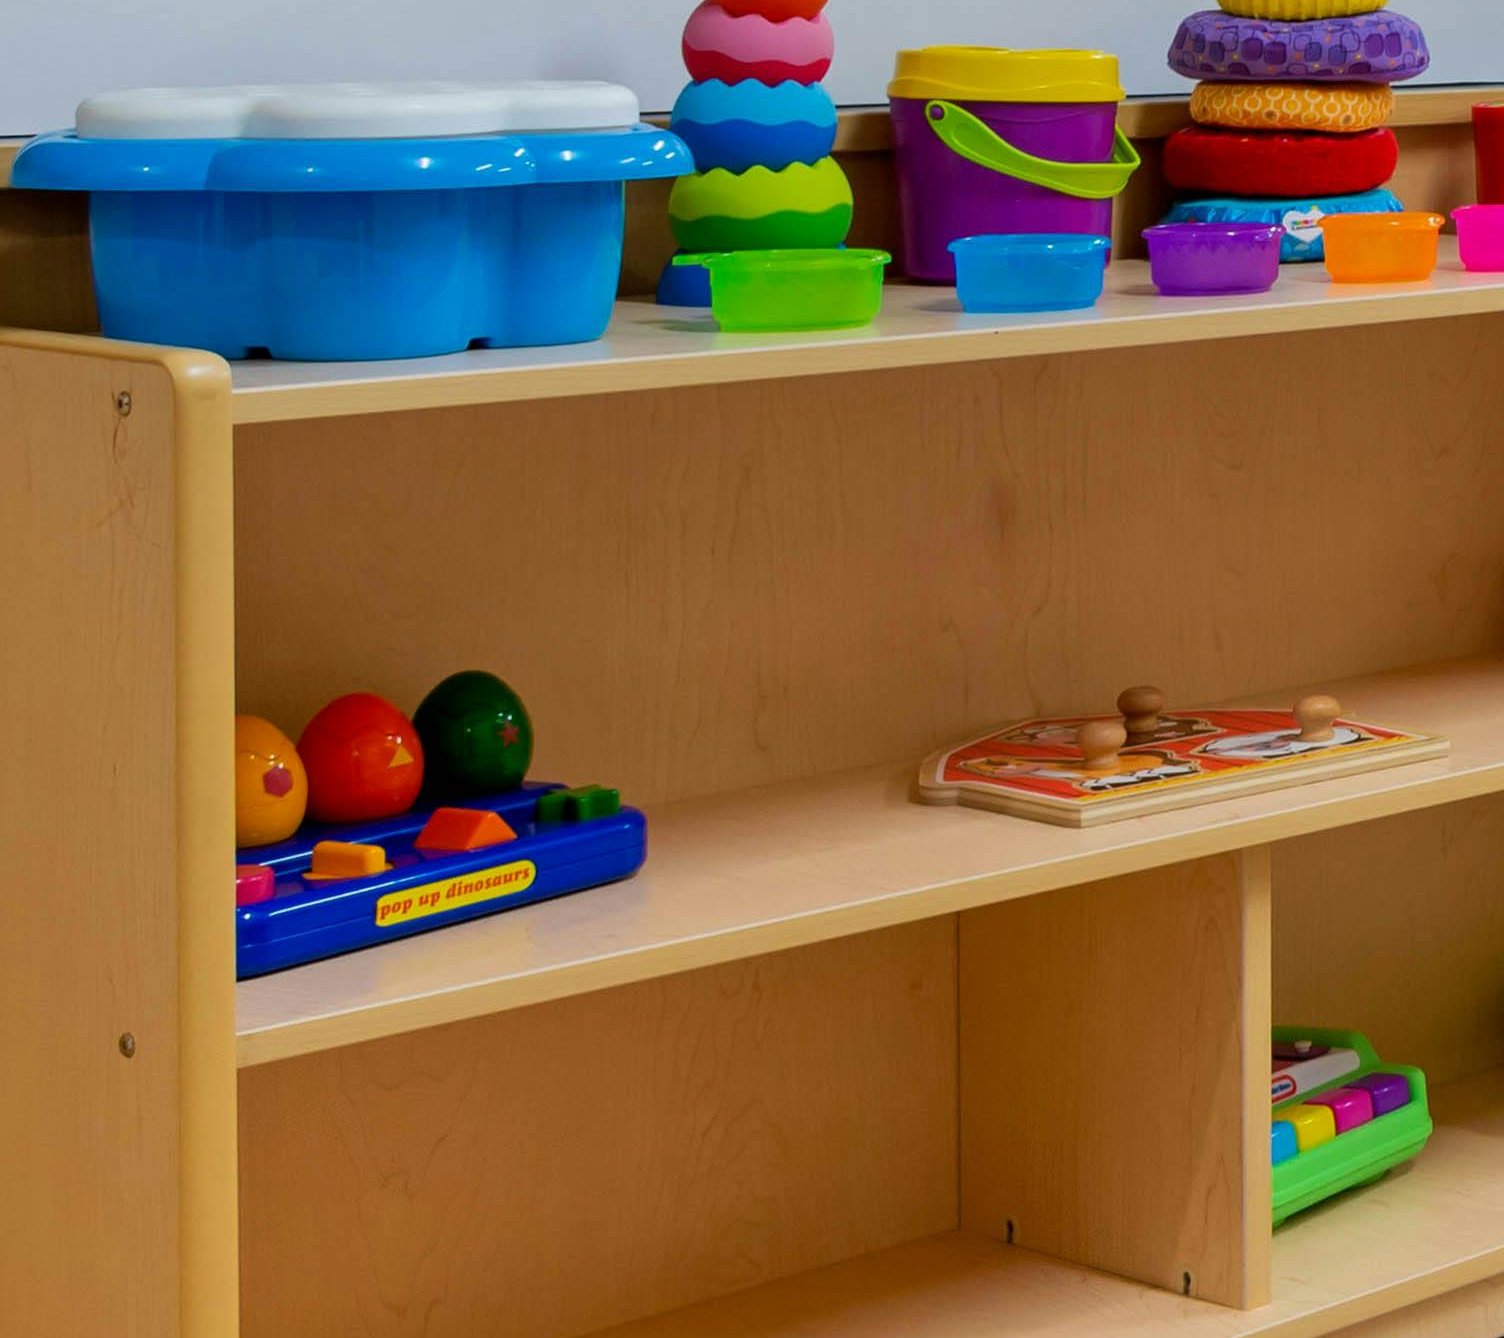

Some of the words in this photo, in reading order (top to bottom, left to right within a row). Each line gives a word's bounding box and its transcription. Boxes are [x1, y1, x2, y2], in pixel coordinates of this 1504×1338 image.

[379, 898, 412, 919] pop
[418, 891, 440, 907] up
[446, 867, 530, 900] dinosaurs
